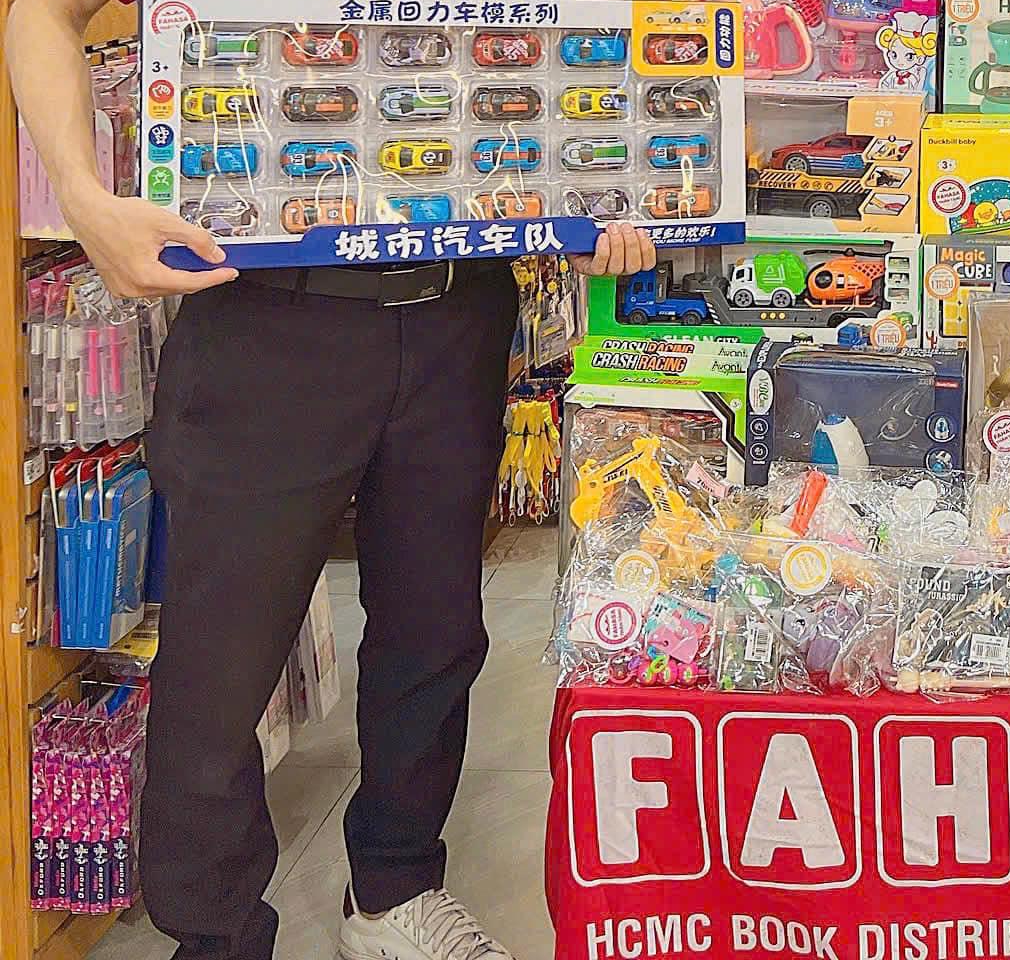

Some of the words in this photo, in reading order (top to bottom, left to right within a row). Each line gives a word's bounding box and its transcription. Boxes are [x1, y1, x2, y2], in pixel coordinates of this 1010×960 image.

[151, 60, 169, 73] 3+
[958, 138, 977, 146] baby
[758, 180, 797, 189] RECOVERY
[334, 221, 563, 259] 城市汽车队
[940, 247, 987, 265] Magic
[952, 263, 993, 279] CUBE
[592, 352, 639, 371] CRASH
[638, 354, 688, 373] RACING
[586, 912, 713, 960] HCMC
[731, 915, 846, 960] BOOK
